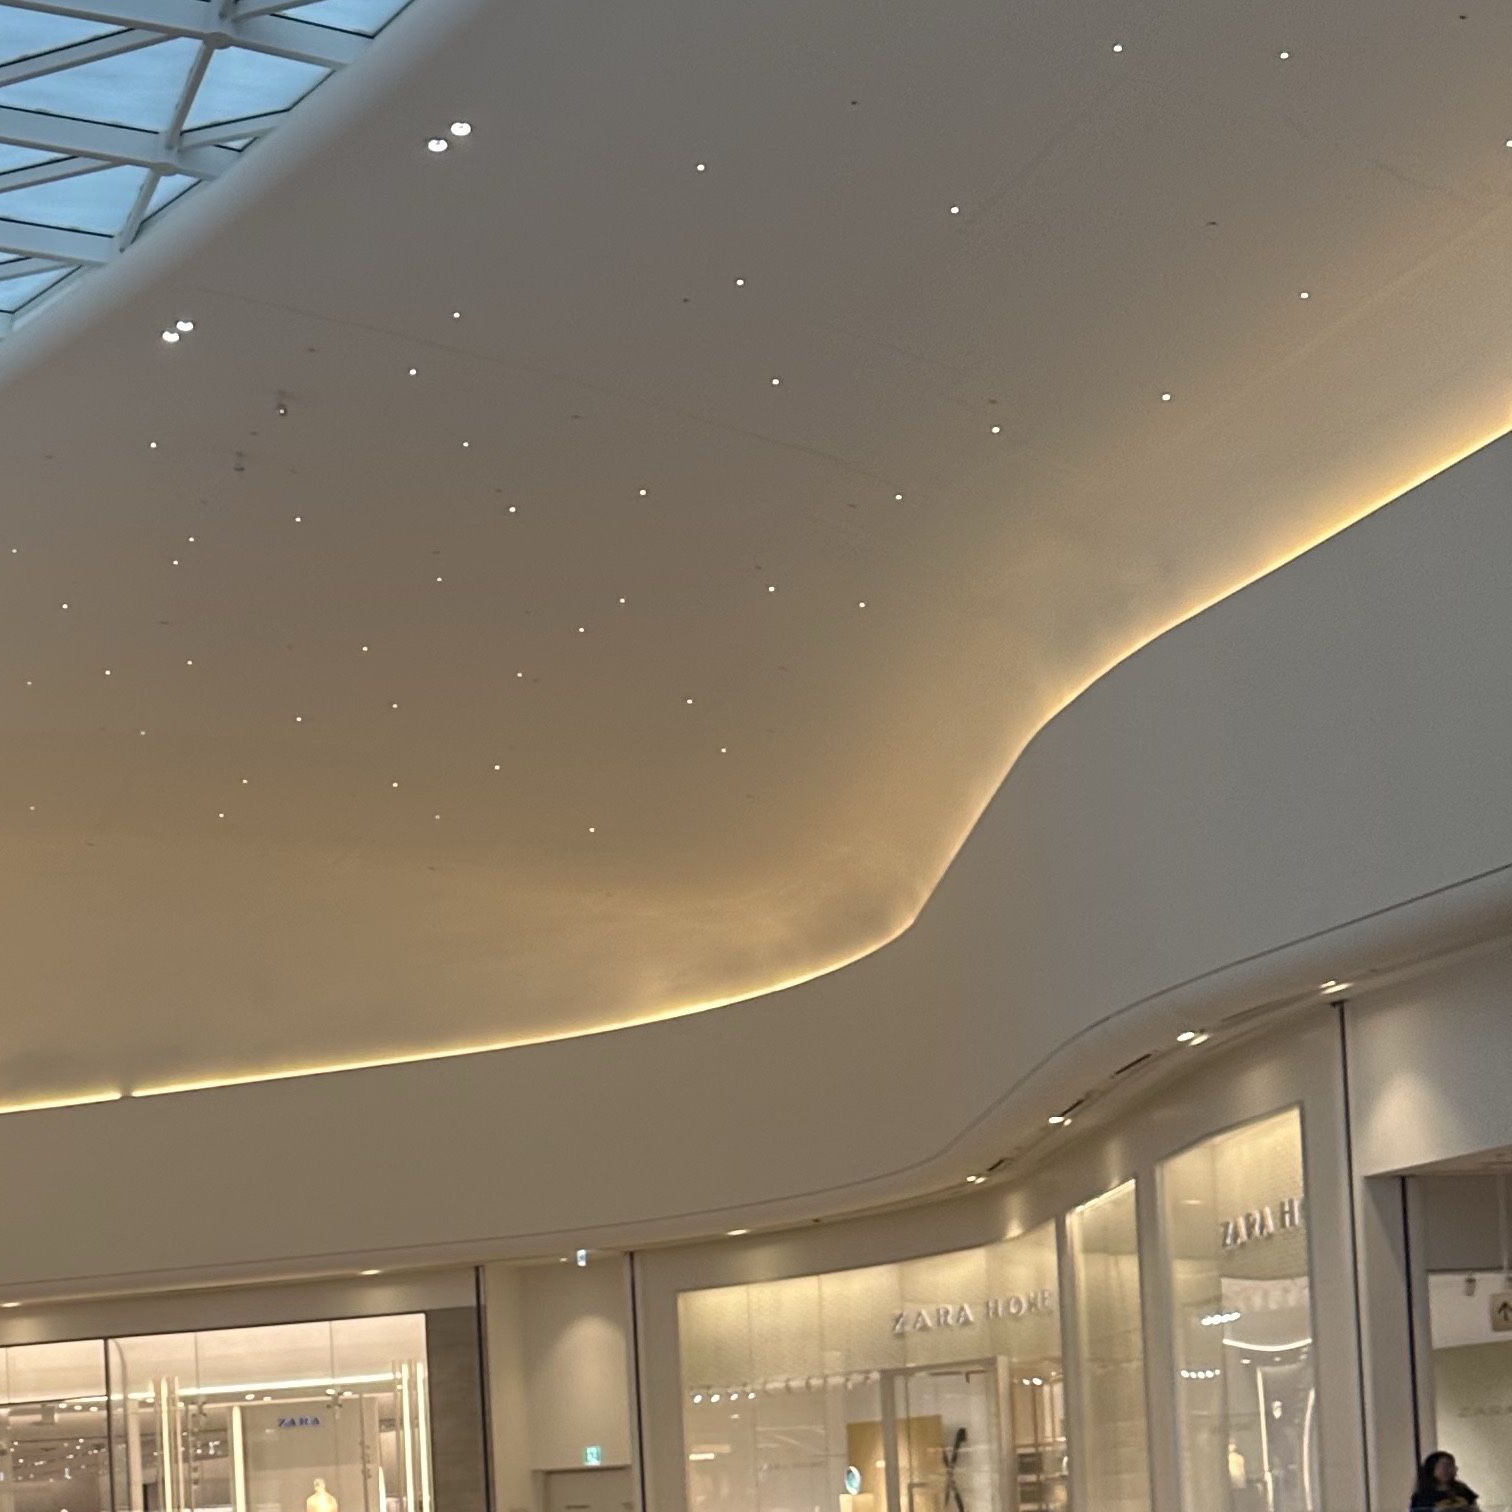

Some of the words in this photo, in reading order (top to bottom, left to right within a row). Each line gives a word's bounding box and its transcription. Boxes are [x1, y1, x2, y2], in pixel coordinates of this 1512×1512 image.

[1220, 1205, 1275, 1247] ZARA
[890, 1302, 975, 1336] ZARA
[984, 1288, 1053, 1319] HOME
[277, 1415, 321, 1428] ZARA
